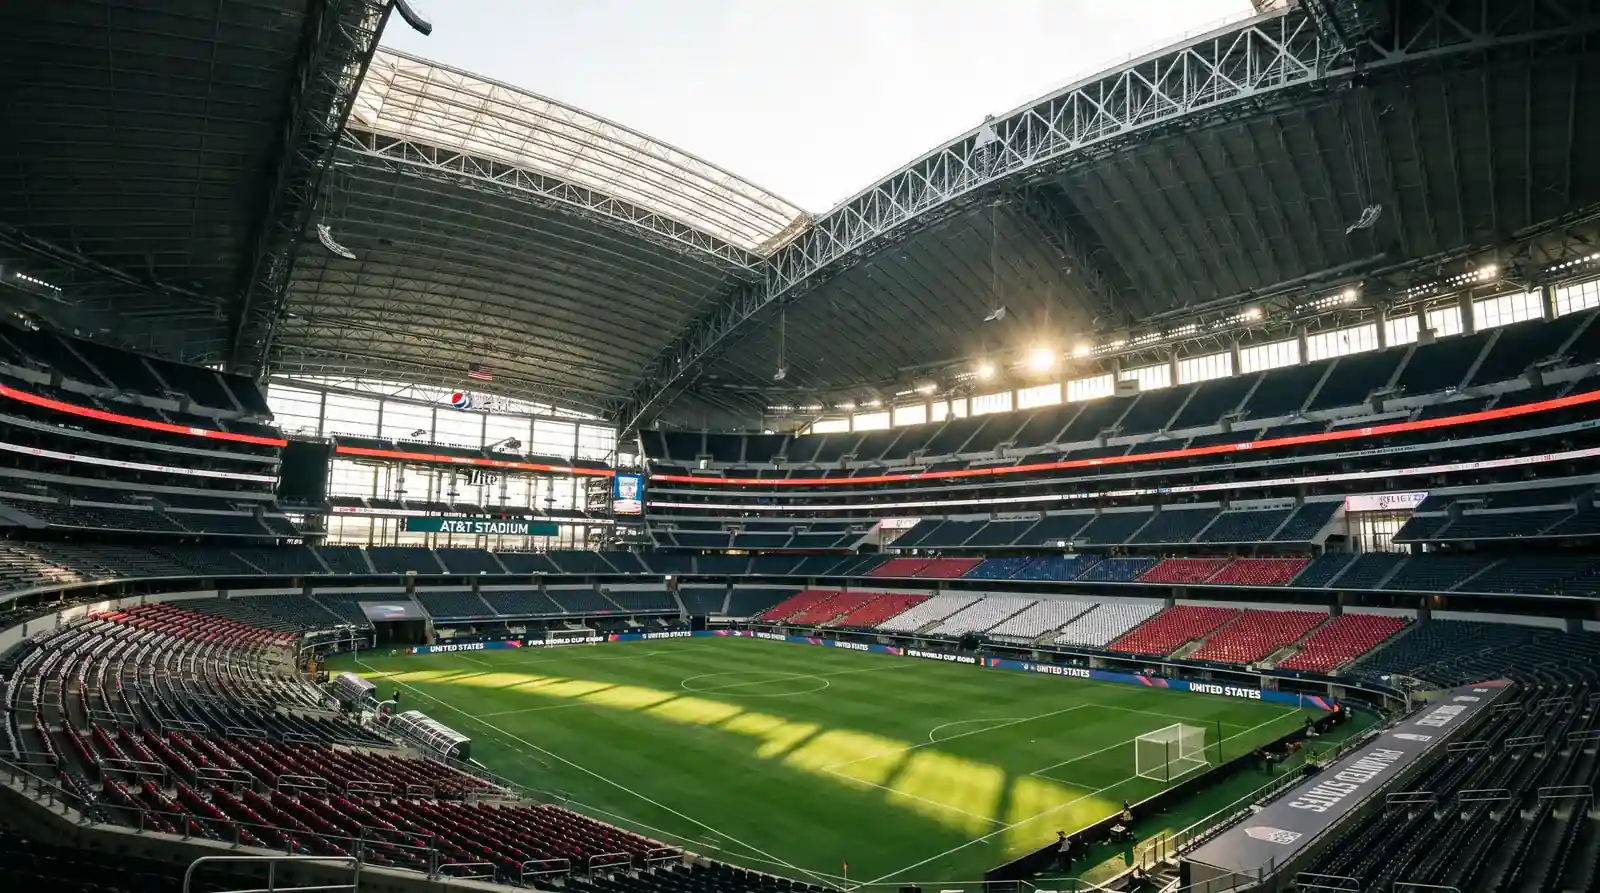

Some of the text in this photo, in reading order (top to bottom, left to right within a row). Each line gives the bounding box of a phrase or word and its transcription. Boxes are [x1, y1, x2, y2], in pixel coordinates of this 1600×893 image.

[440, 520, 528, 535] AT&T STADIUM
[430, 643, 484, 652] UNITED STATES
[1036, 664, 1090, 678] UNITED STATES
[1189, 682, 1261, 699] UNITED STATES
